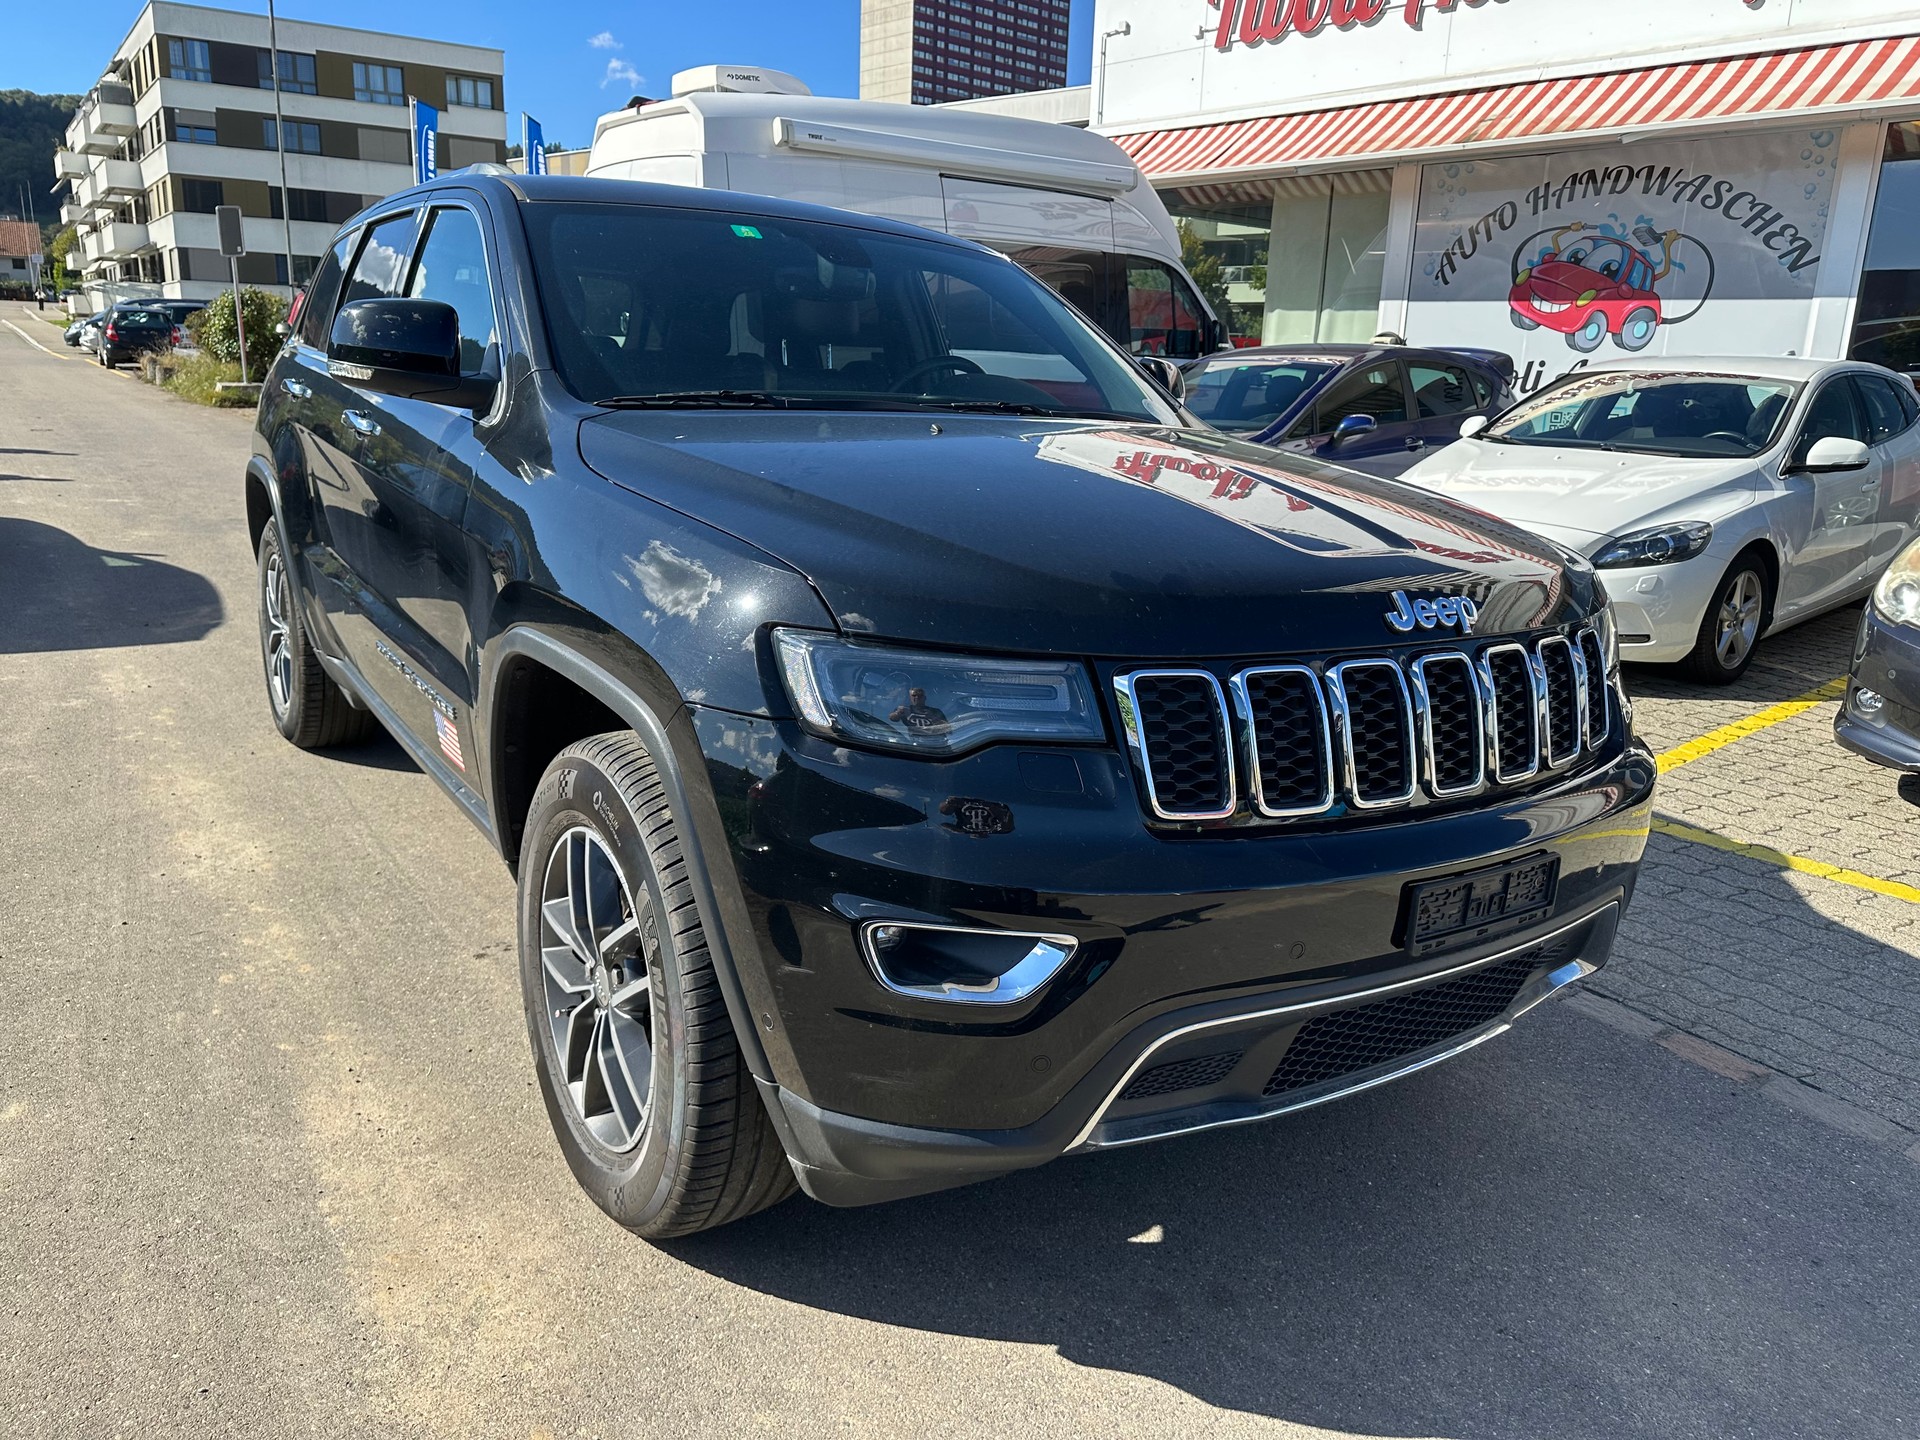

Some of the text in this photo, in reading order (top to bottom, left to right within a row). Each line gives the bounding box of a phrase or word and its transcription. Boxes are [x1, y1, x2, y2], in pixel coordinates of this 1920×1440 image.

[734, 73, 760, 82] DOMETIC
[1434, 164, 1821, 286] AUTO HANDWASCHEN
[1384, 590, 1478, 634] Jeep
